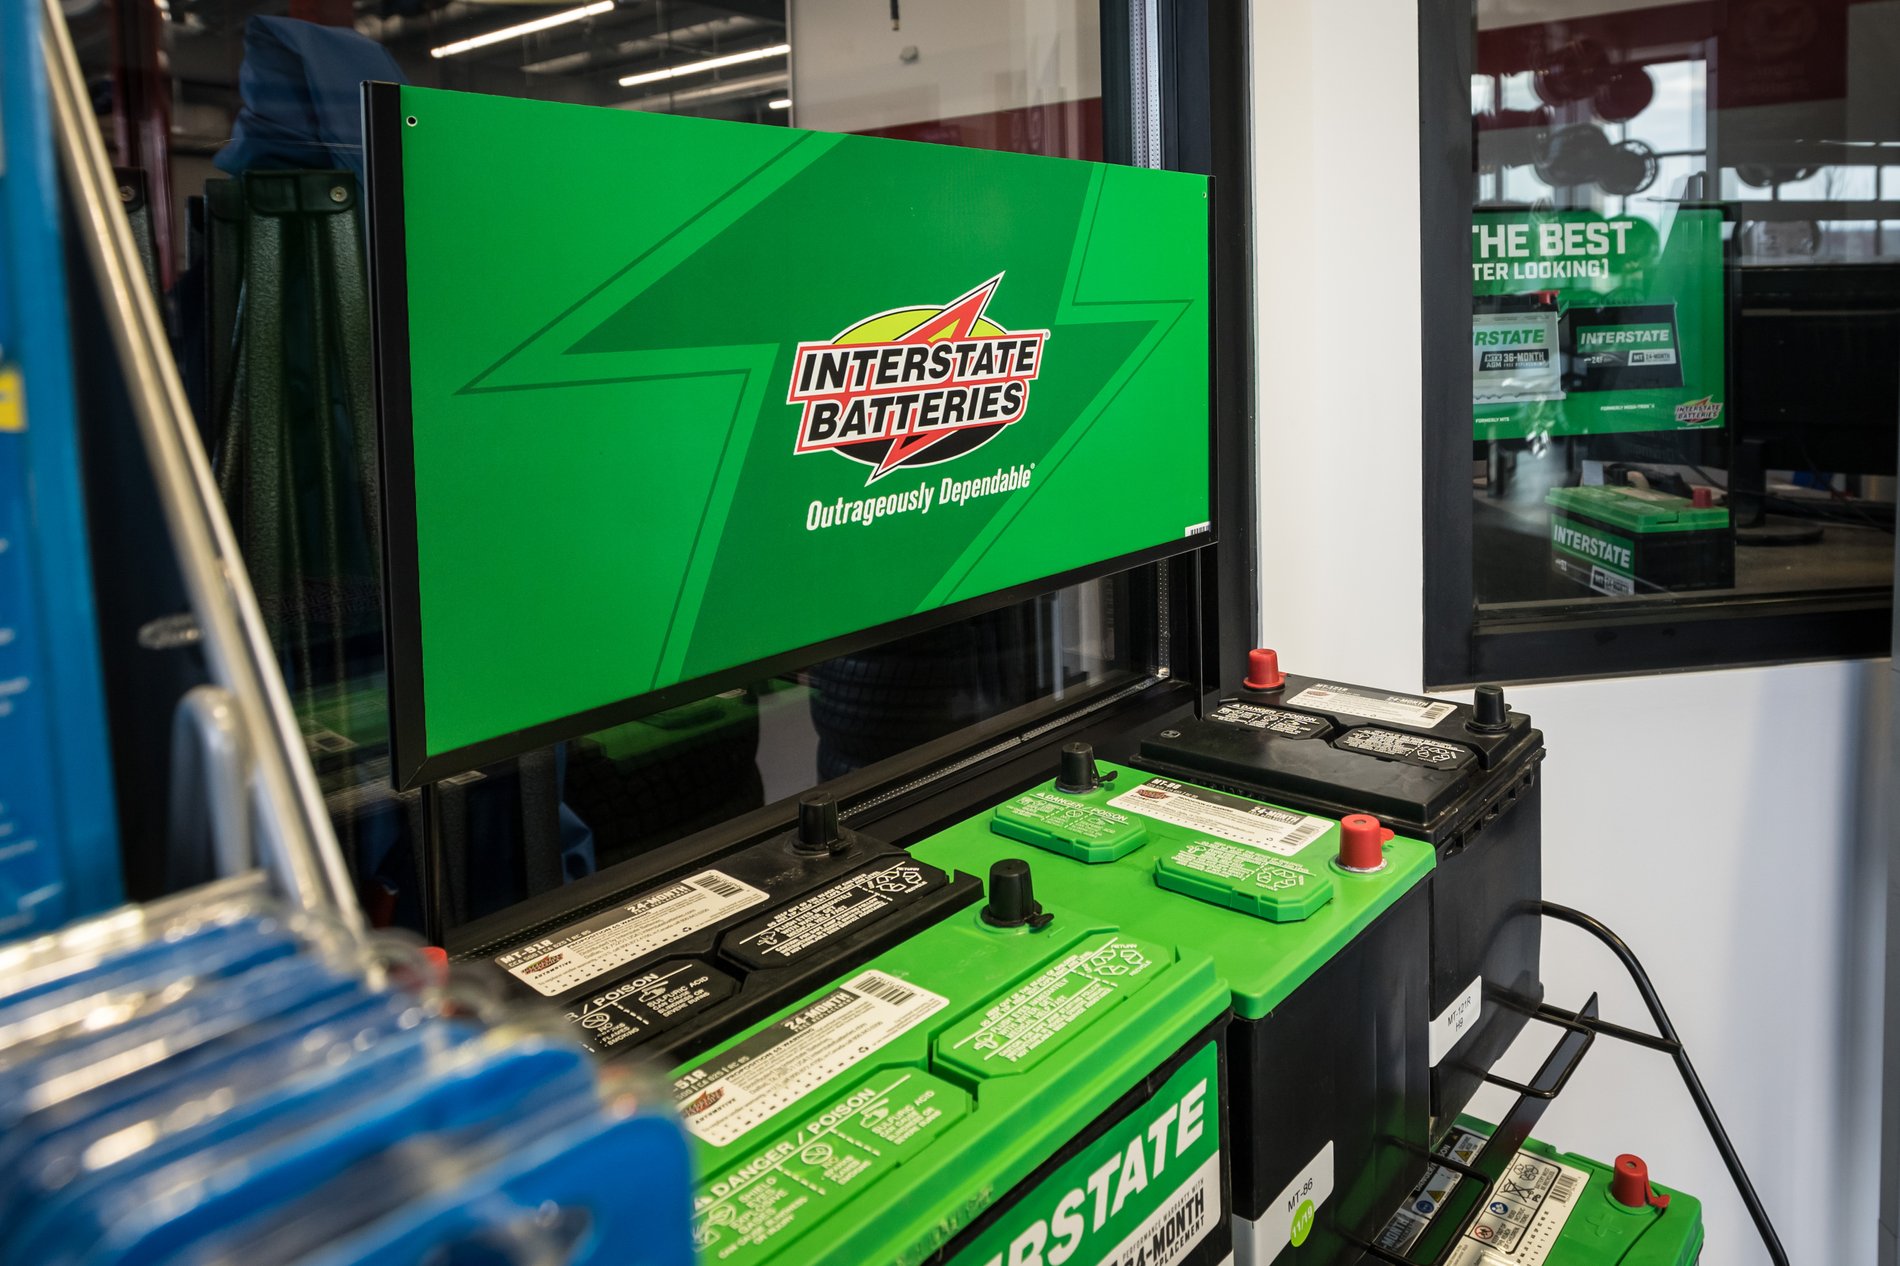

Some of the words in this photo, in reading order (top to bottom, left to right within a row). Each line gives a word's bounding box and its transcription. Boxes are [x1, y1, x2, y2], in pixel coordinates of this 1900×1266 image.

[1539, 221, 1632, 256] BEST
[1473, 328, 1545, 346] RSTATE
[1580, 330, 1669, 344] INTERSTATE
[800, 339, 1038, 392] INTERSTATE
[1503, 351, 1544, 362] 36-MONTH
[808, 381, 1024, 441] BATTERIES
[805, 481, 935, 531] Outrageously
[1554, 525, 1631, 568] INTERSTATE
[1044, 794, 1084, 809] DANGER
[1091, 808, 1128, 821] POISON
[625, 885, 689, 912] 24-MONTH
[773, 919, 797, 932] FLUSH
[794, 911, 814, 921] EYES
[811, 891, 853, 913] IMMEDIATELY
[499, 938, 555, 963] MT-51R
[532, 960, 573, 979] AUTOMOTIVE
[689, 976, 709, 988] ACID
[592, 973, 659, 1007] POISON
[652, 1001, 669, 1011] CAN
[668, 990, 691, 1003] CAUSE
[782, 992, 851, 1030] 24-MONTH
[1447, 995, 1472, 1027] MT-121R
[597, 1022, 613, 1033] NO
[602, 1026, 630, 1042] FLAMES
[606, 1026, 640, 1046] SMOKING
[693, 1097, 738, 1124] AUTOMOTIVE
[914, 1090, 935, 1107] ACID
[711, 1141, 795, 1198] DANGER
[807, 1088, 876, 1135] POISON
[983, 1078, 1208, 1266] RSTATE
[1534, 1175, 1545, 1189] BATTERY
[1541, 1167, 1550, 1176] MUST
[1287, 1178, 1313, 1212] MT-86
[1531, 1193, 1541, 1202] Pb
[1122, 1220, 1162, 1259] PERFORMANCE
[1163, 1190, 1190, 1222] WARRANTY
[1191, 1177, 1204, 1195] WITH
[1154, 1214, 1205, 1266] PLACEMENT
